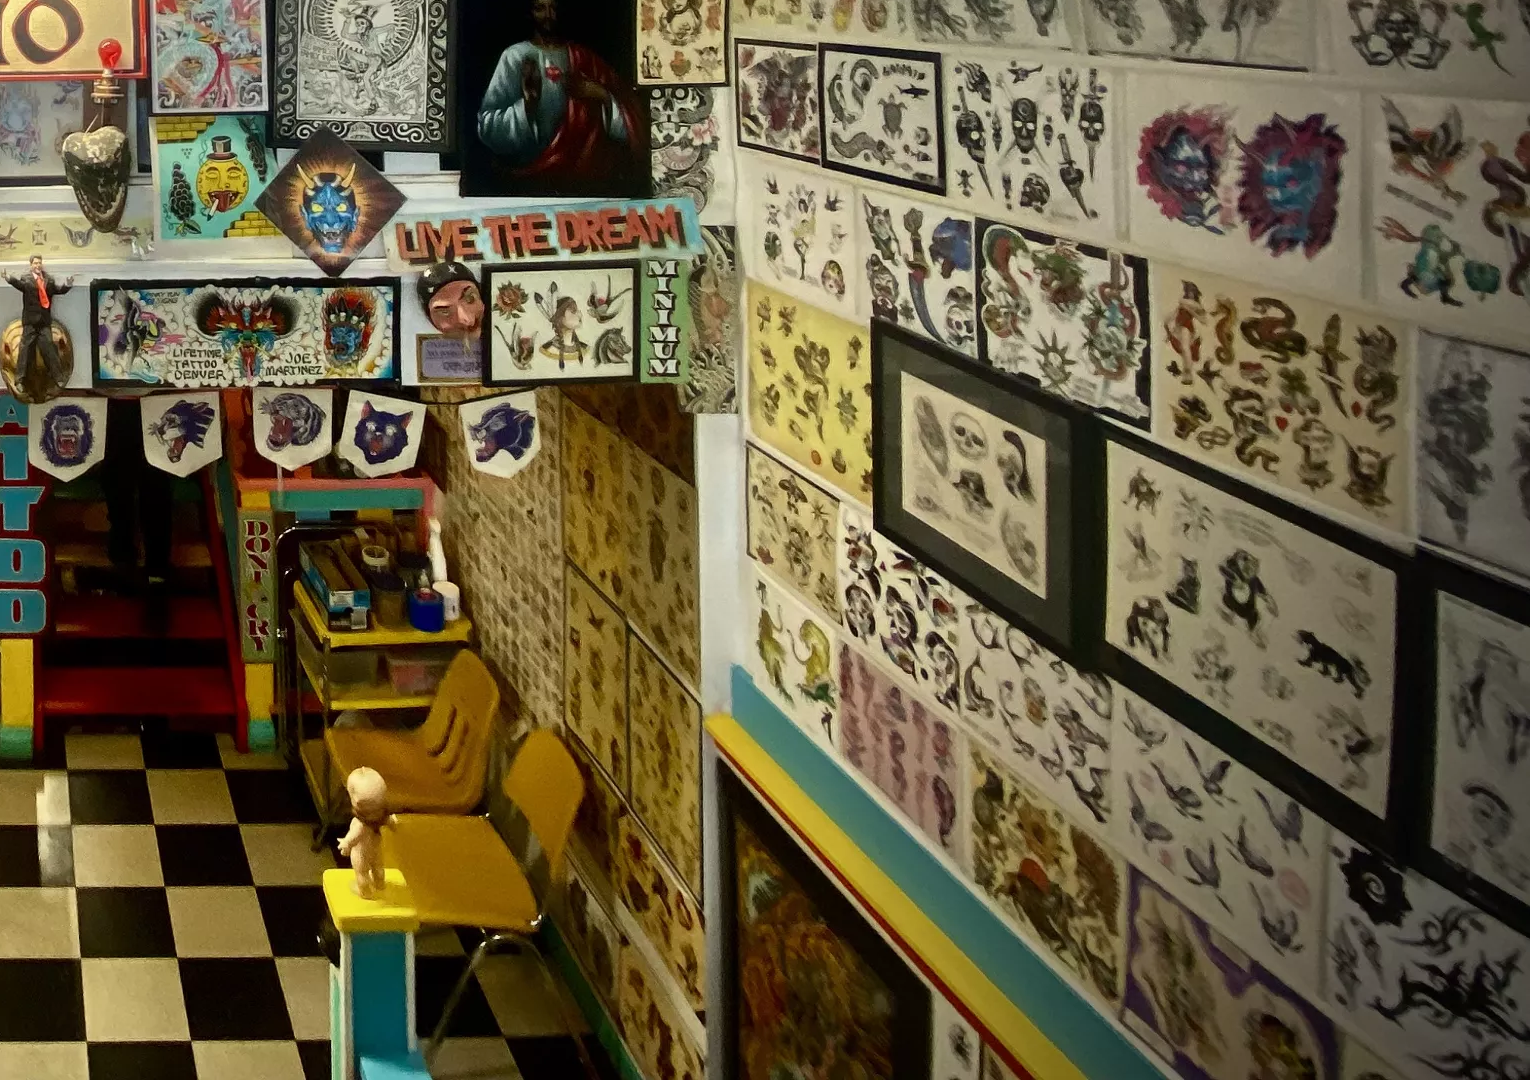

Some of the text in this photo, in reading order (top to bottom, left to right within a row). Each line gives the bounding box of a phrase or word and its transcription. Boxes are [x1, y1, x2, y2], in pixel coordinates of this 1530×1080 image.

[396, 204, 687, 261] LIVE THE DREAM
[647, 260, 679, 377] MINIMUM
[172, 348, 222, 359] LIFETIME
[285, 351, 312, 365] JOE
[174, 359, 217, 369] TATTOO
[265, 364, 324, 377] MARTINEZ
[174, 370, 226, 381] DENVER
